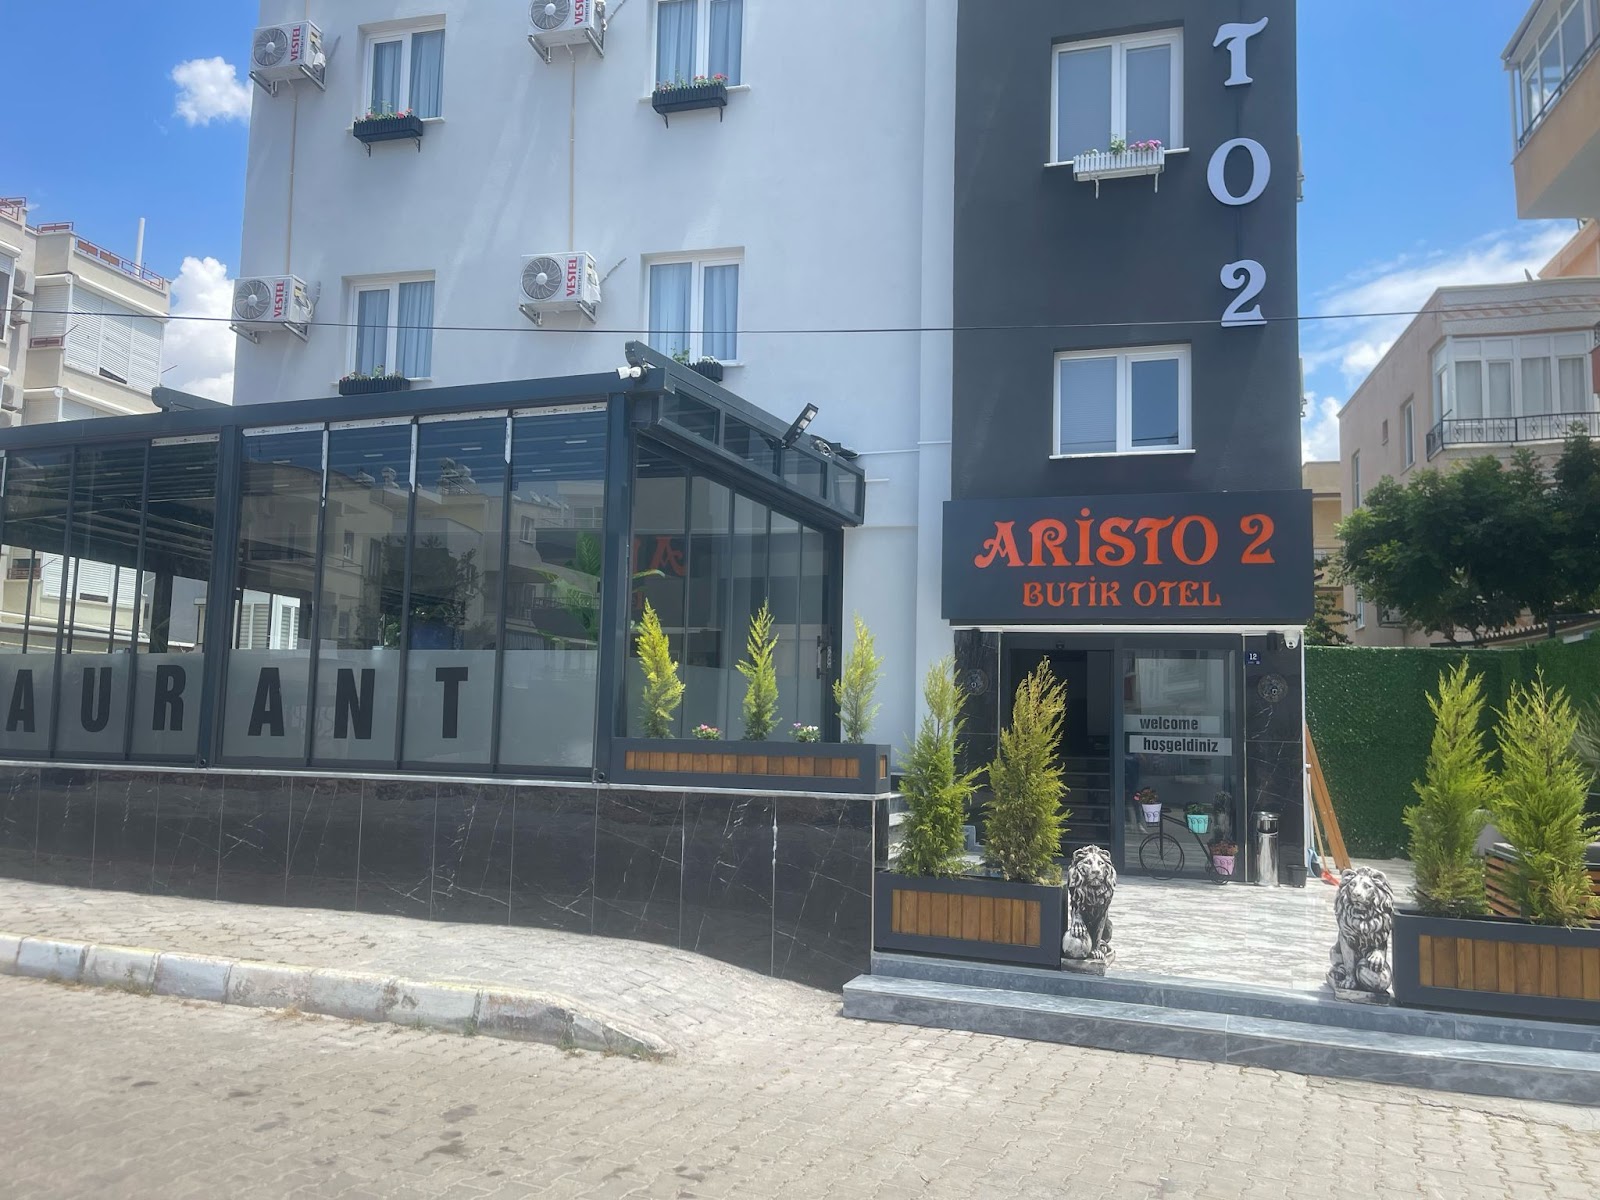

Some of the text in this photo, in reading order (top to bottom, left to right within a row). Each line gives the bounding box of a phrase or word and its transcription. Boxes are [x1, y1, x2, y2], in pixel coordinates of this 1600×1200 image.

[290, 26, 301, 62] VESTEL
[566, 256, 578, 297] VESTEL
[274, 281, 285, 318] VESTEL
[974, 508, 1276, 568] ARİSTO 2
[1022, 576, 1222, 607] BUTİK OTEL
[1249, 653, 1258, 661] 12
[1140, 716, 1199, 730] welcome
[1143, 737, 1219, 753] hoşgeldiniz
